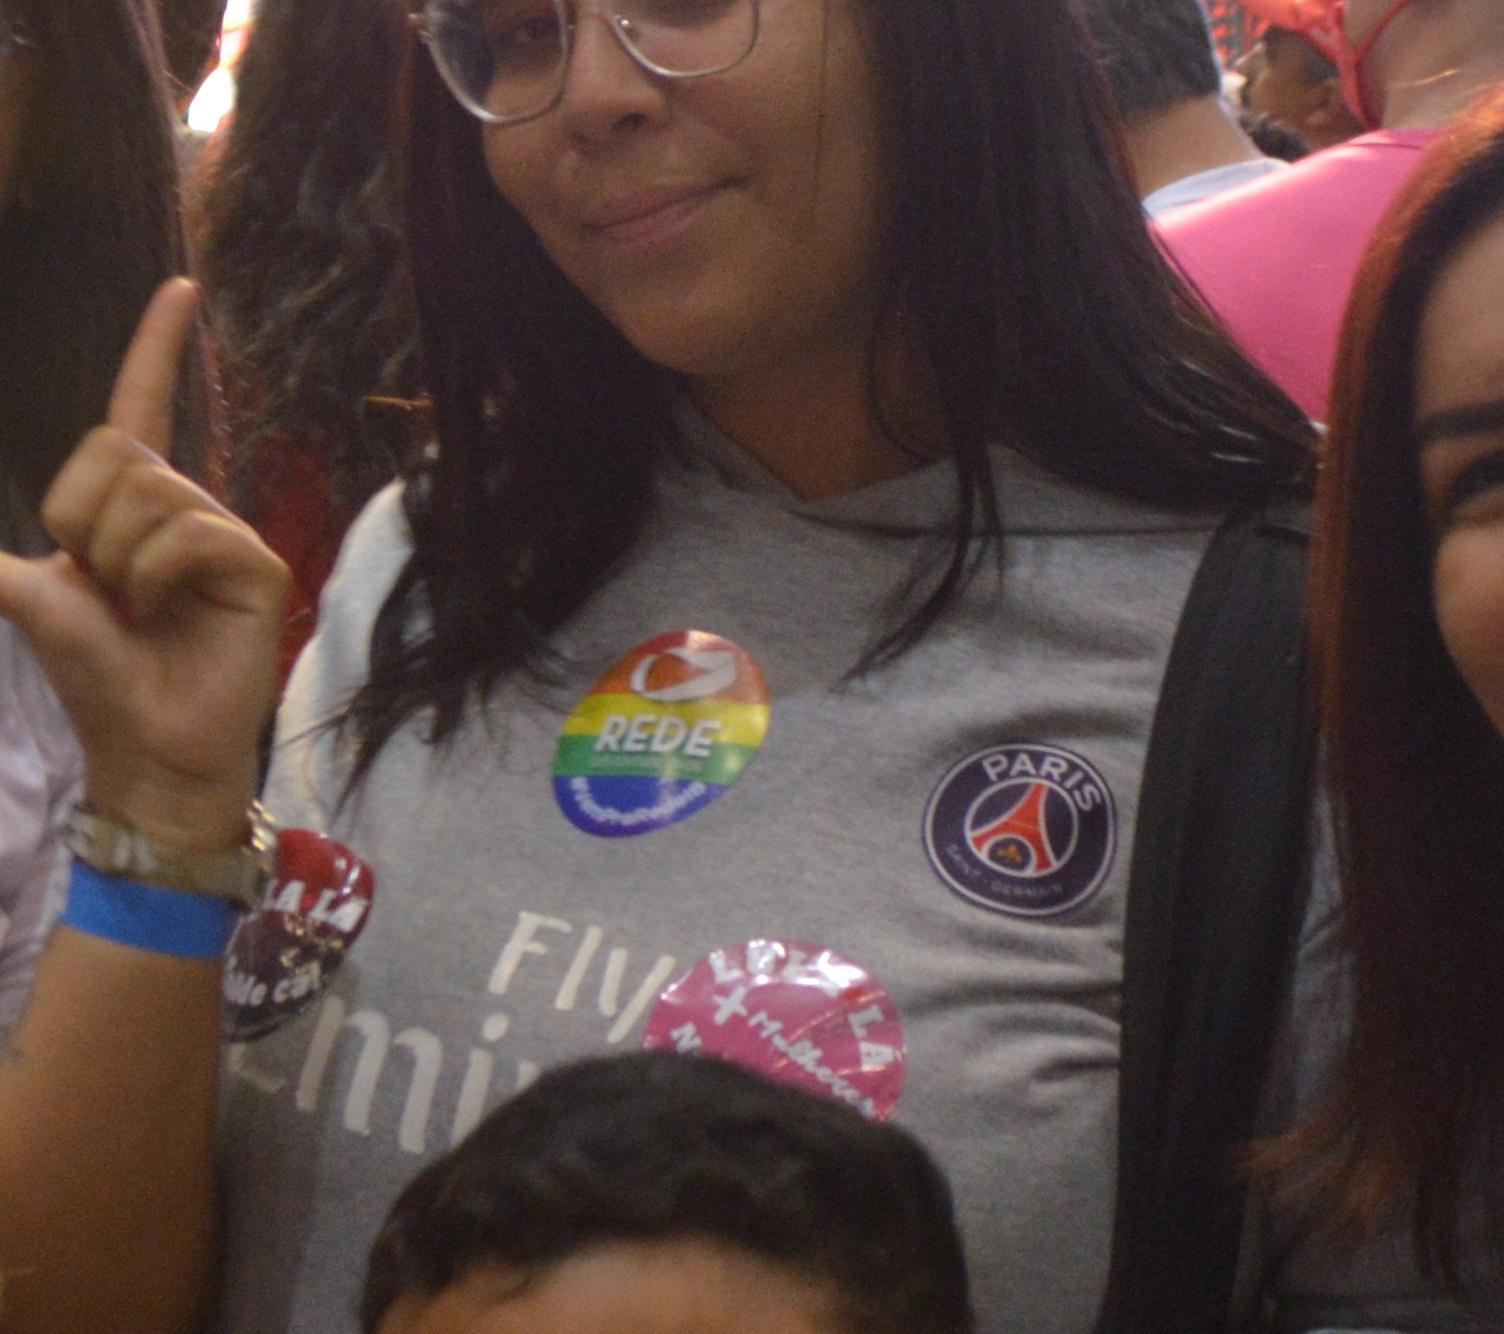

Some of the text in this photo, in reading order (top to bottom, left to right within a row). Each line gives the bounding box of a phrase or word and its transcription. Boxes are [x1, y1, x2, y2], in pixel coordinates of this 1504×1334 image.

[596, 713, 723, 760] REDE
[982, 753, 1101, 813] PARIS
[489, 911, 677, 1044] Fly
